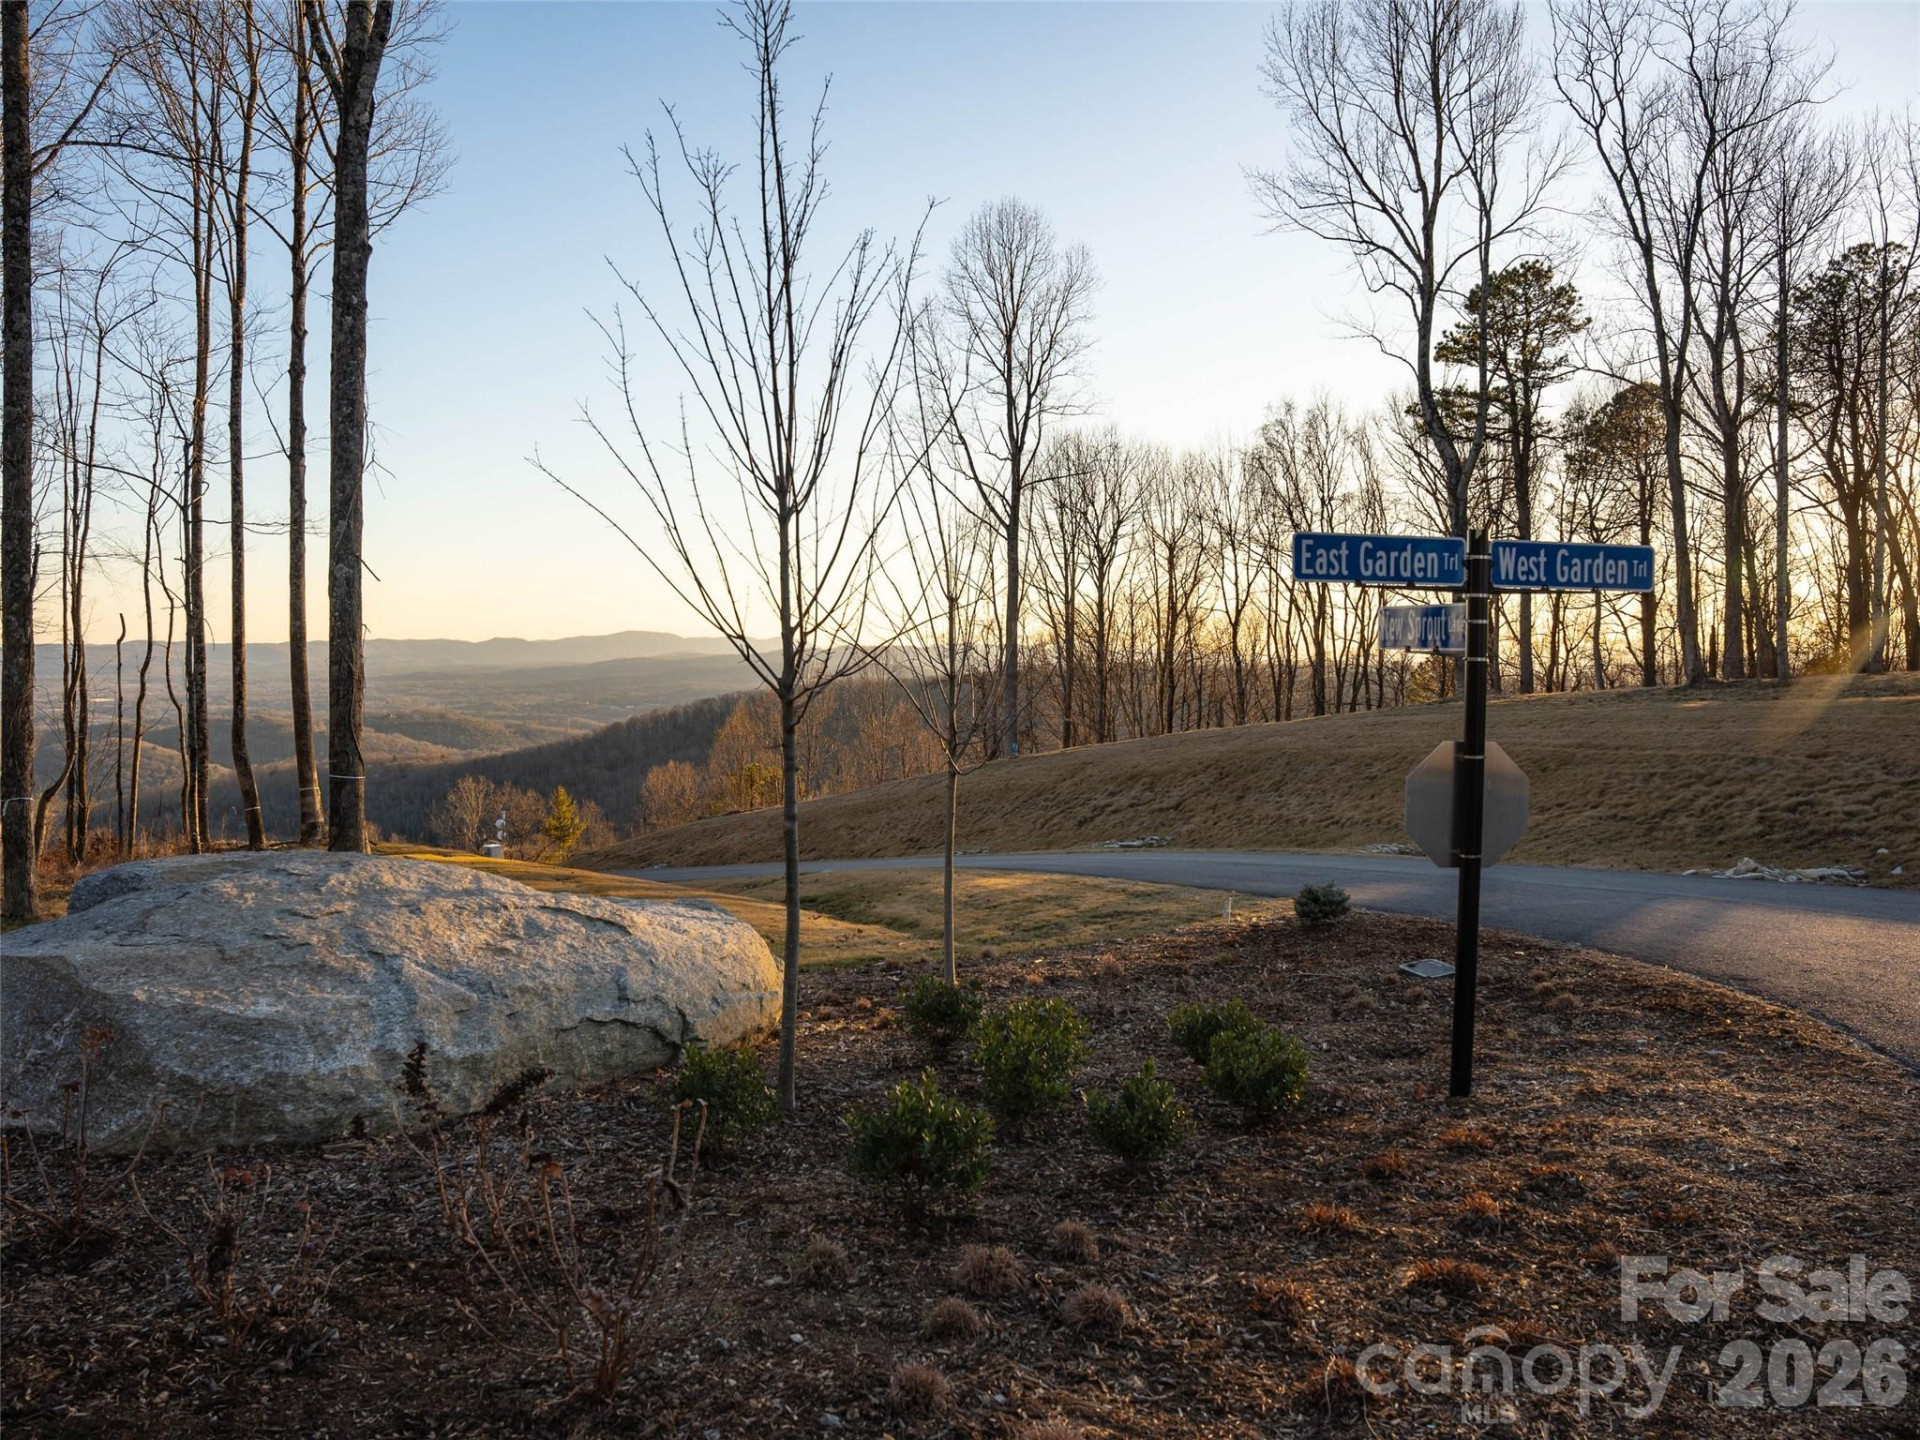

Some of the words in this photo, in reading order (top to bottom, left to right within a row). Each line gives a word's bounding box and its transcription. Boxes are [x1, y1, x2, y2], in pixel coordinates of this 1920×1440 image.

[1301, 539, 1349, 576] East
[1359, 540, 1439, 578] Garden
[1443, 552, 1459, 571] Trl
[1498, 546, 1547, 582] West
[1556, 549, 1628, 585] Garden
[1632, 559, 1648, 578] Trl
[1407, 608, 1447, 645] Sprout
